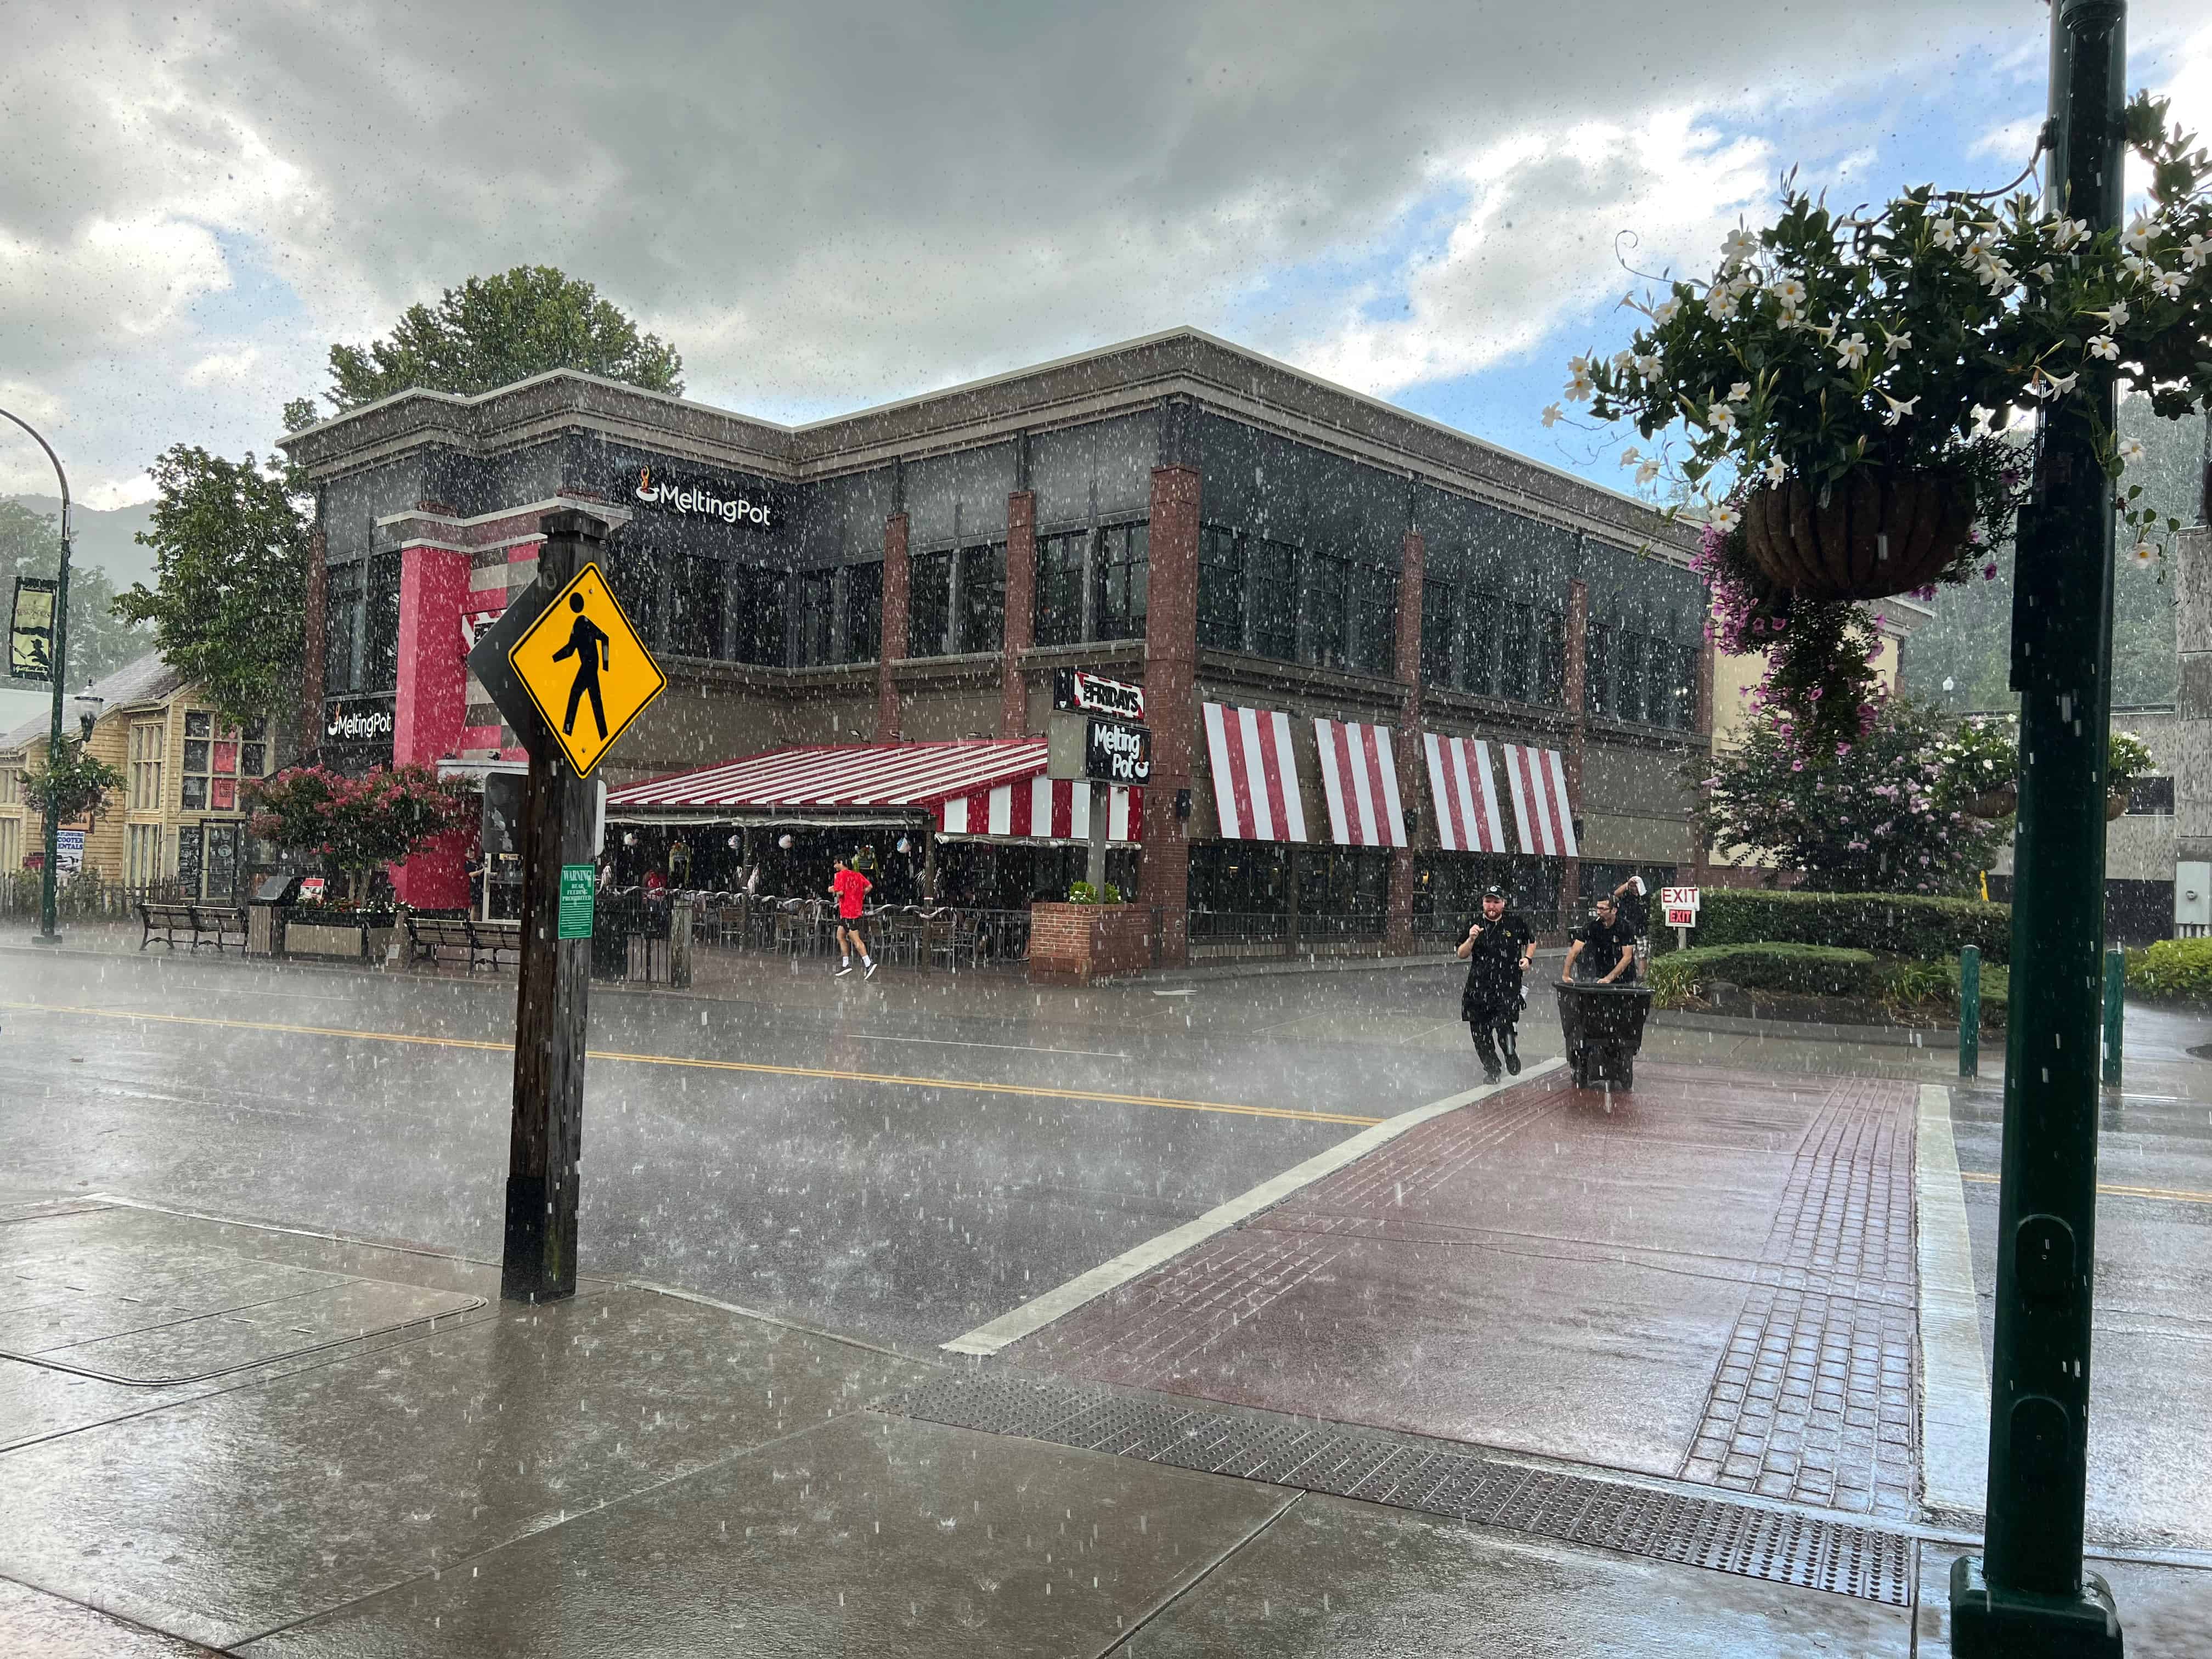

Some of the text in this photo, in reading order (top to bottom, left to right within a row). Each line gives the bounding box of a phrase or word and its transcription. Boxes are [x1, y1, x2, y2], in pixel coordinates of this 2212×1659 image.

[1089, 681, 1138, 712] FRIDAYS
[1094, 724, 1140, 759] Melting
[1113, 753, 1133, 778] Pot
[1662, 889, 1697, 903] EXIT
[1669, 910, 1691, 922] EXIT
